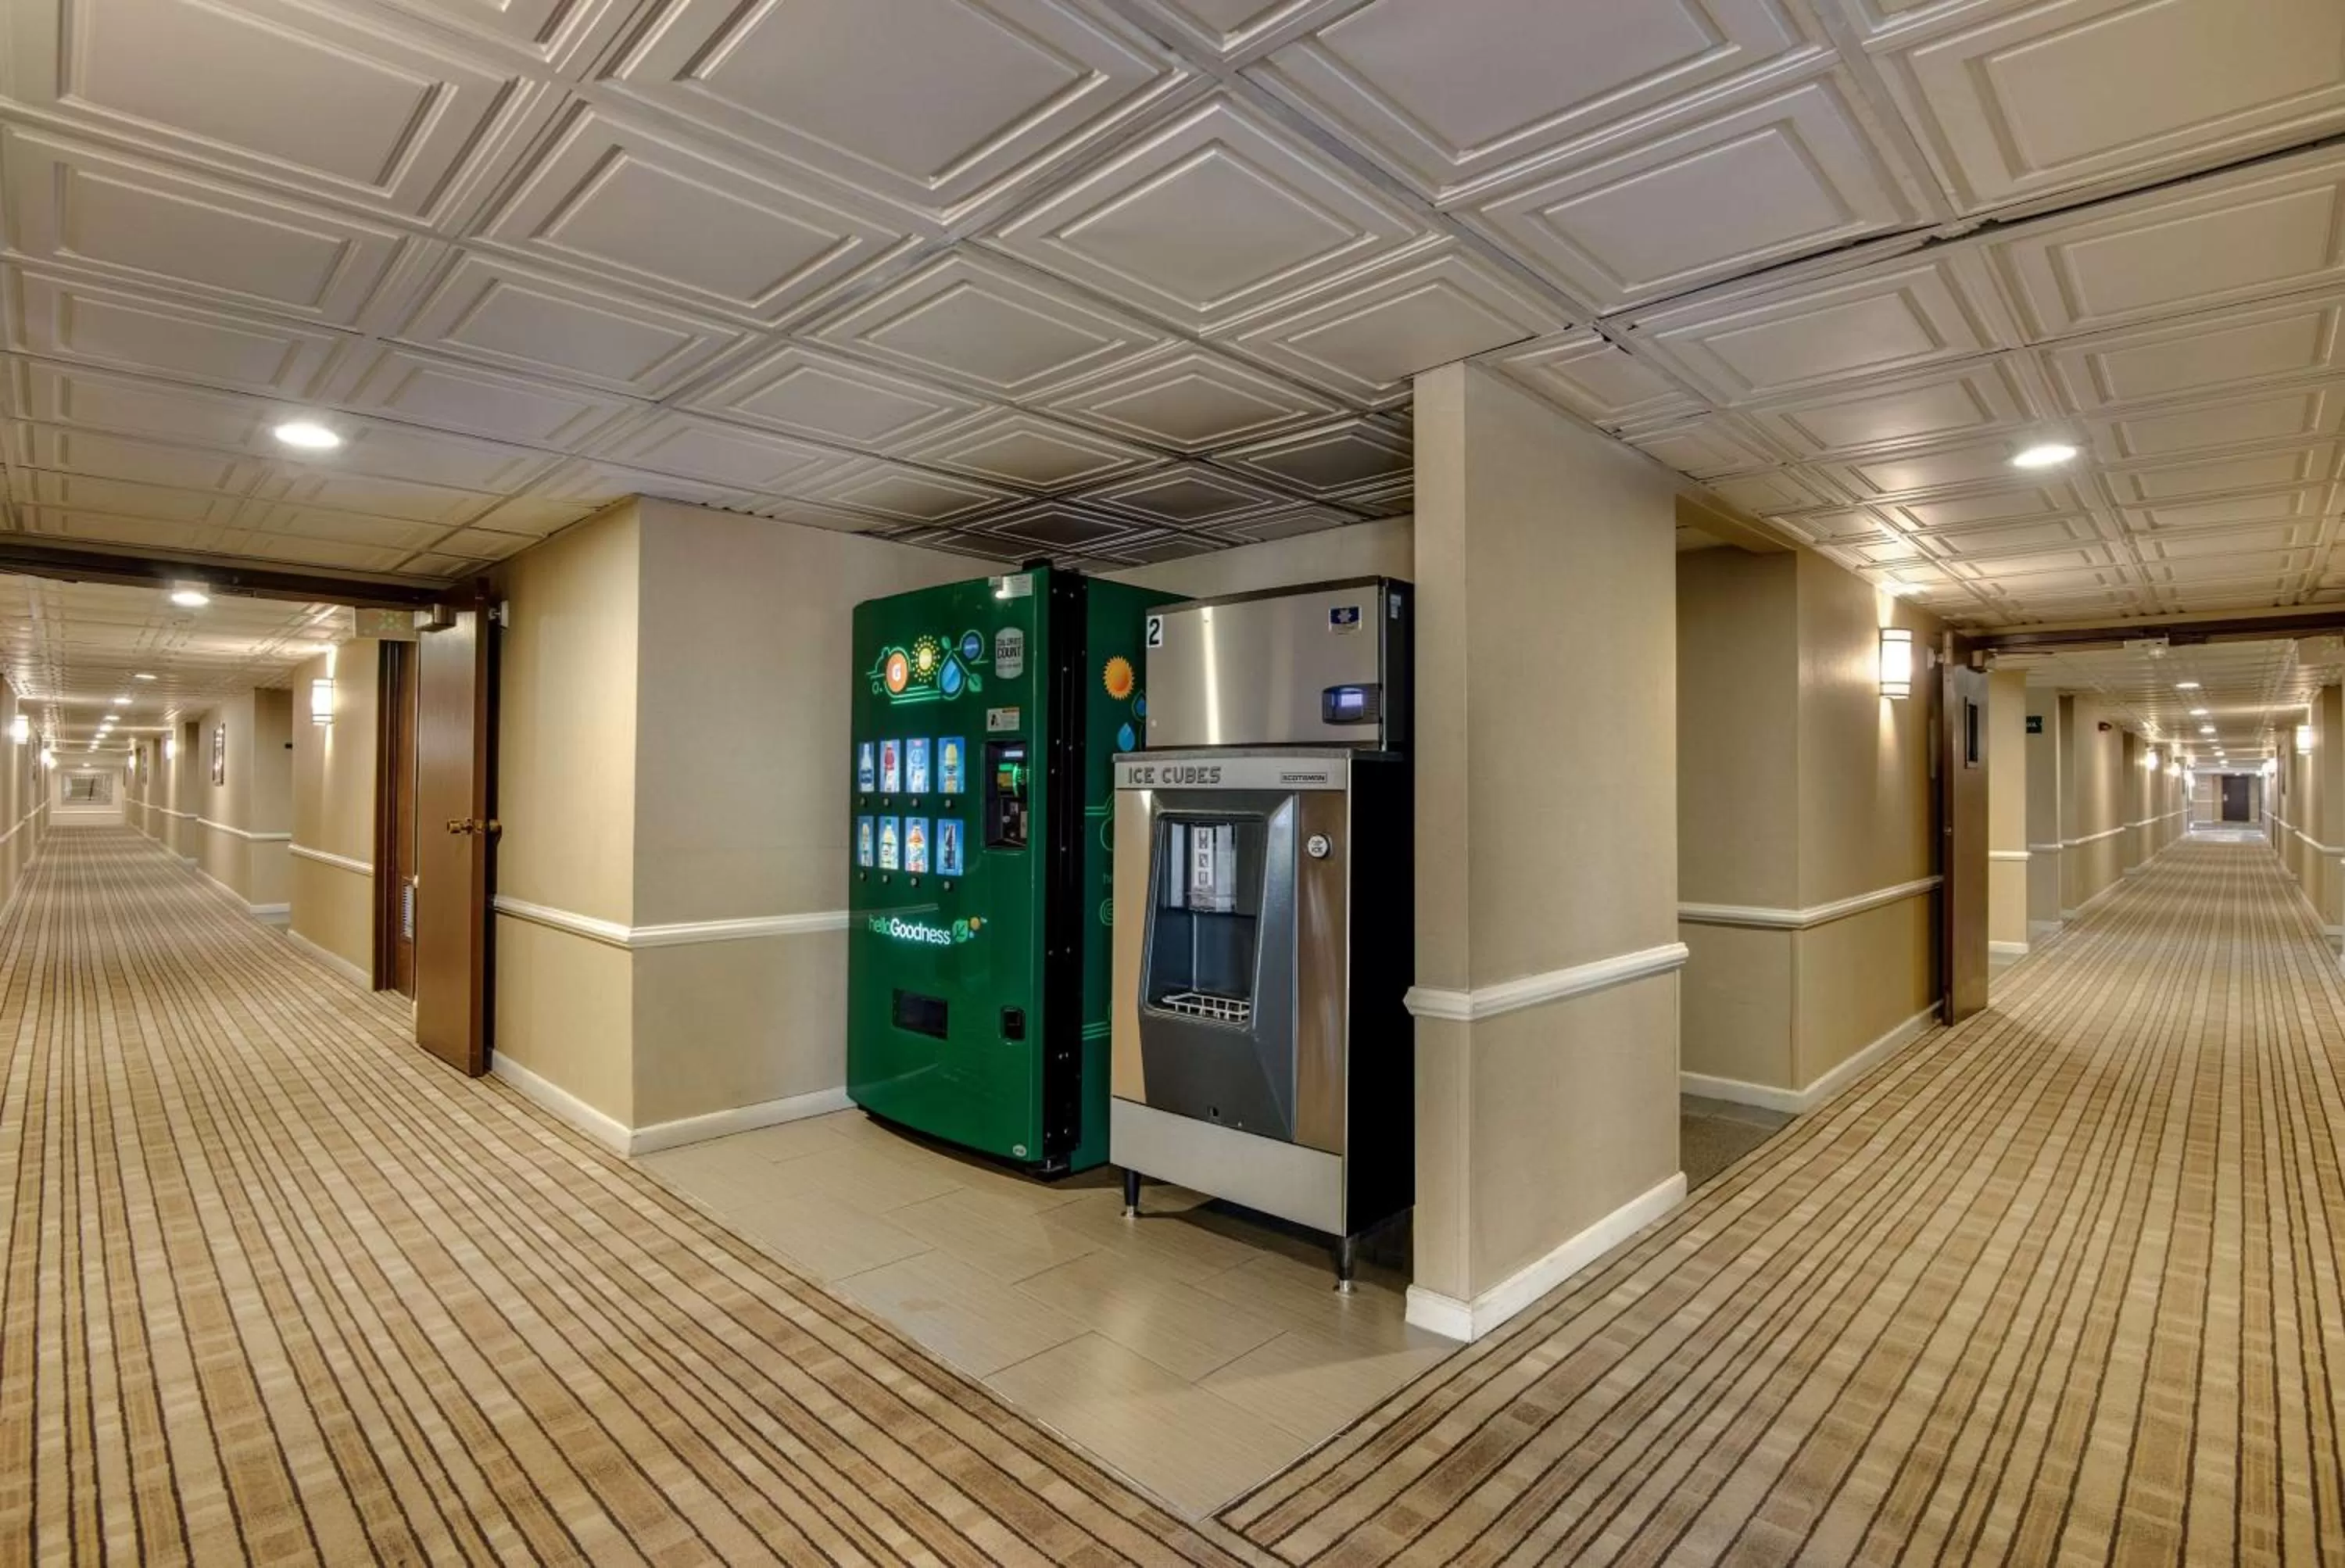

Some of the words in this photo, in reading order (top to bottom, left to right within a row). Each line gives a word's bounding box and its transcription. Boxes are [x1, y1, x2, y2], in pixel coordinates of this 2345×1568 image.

[1149, 618, 1160, 645] 2
[997, 647, 1022, 659] COUNT
[1128, 767, 1155, 784] ICE
[1162, 766, 1222, 784] CUBES
